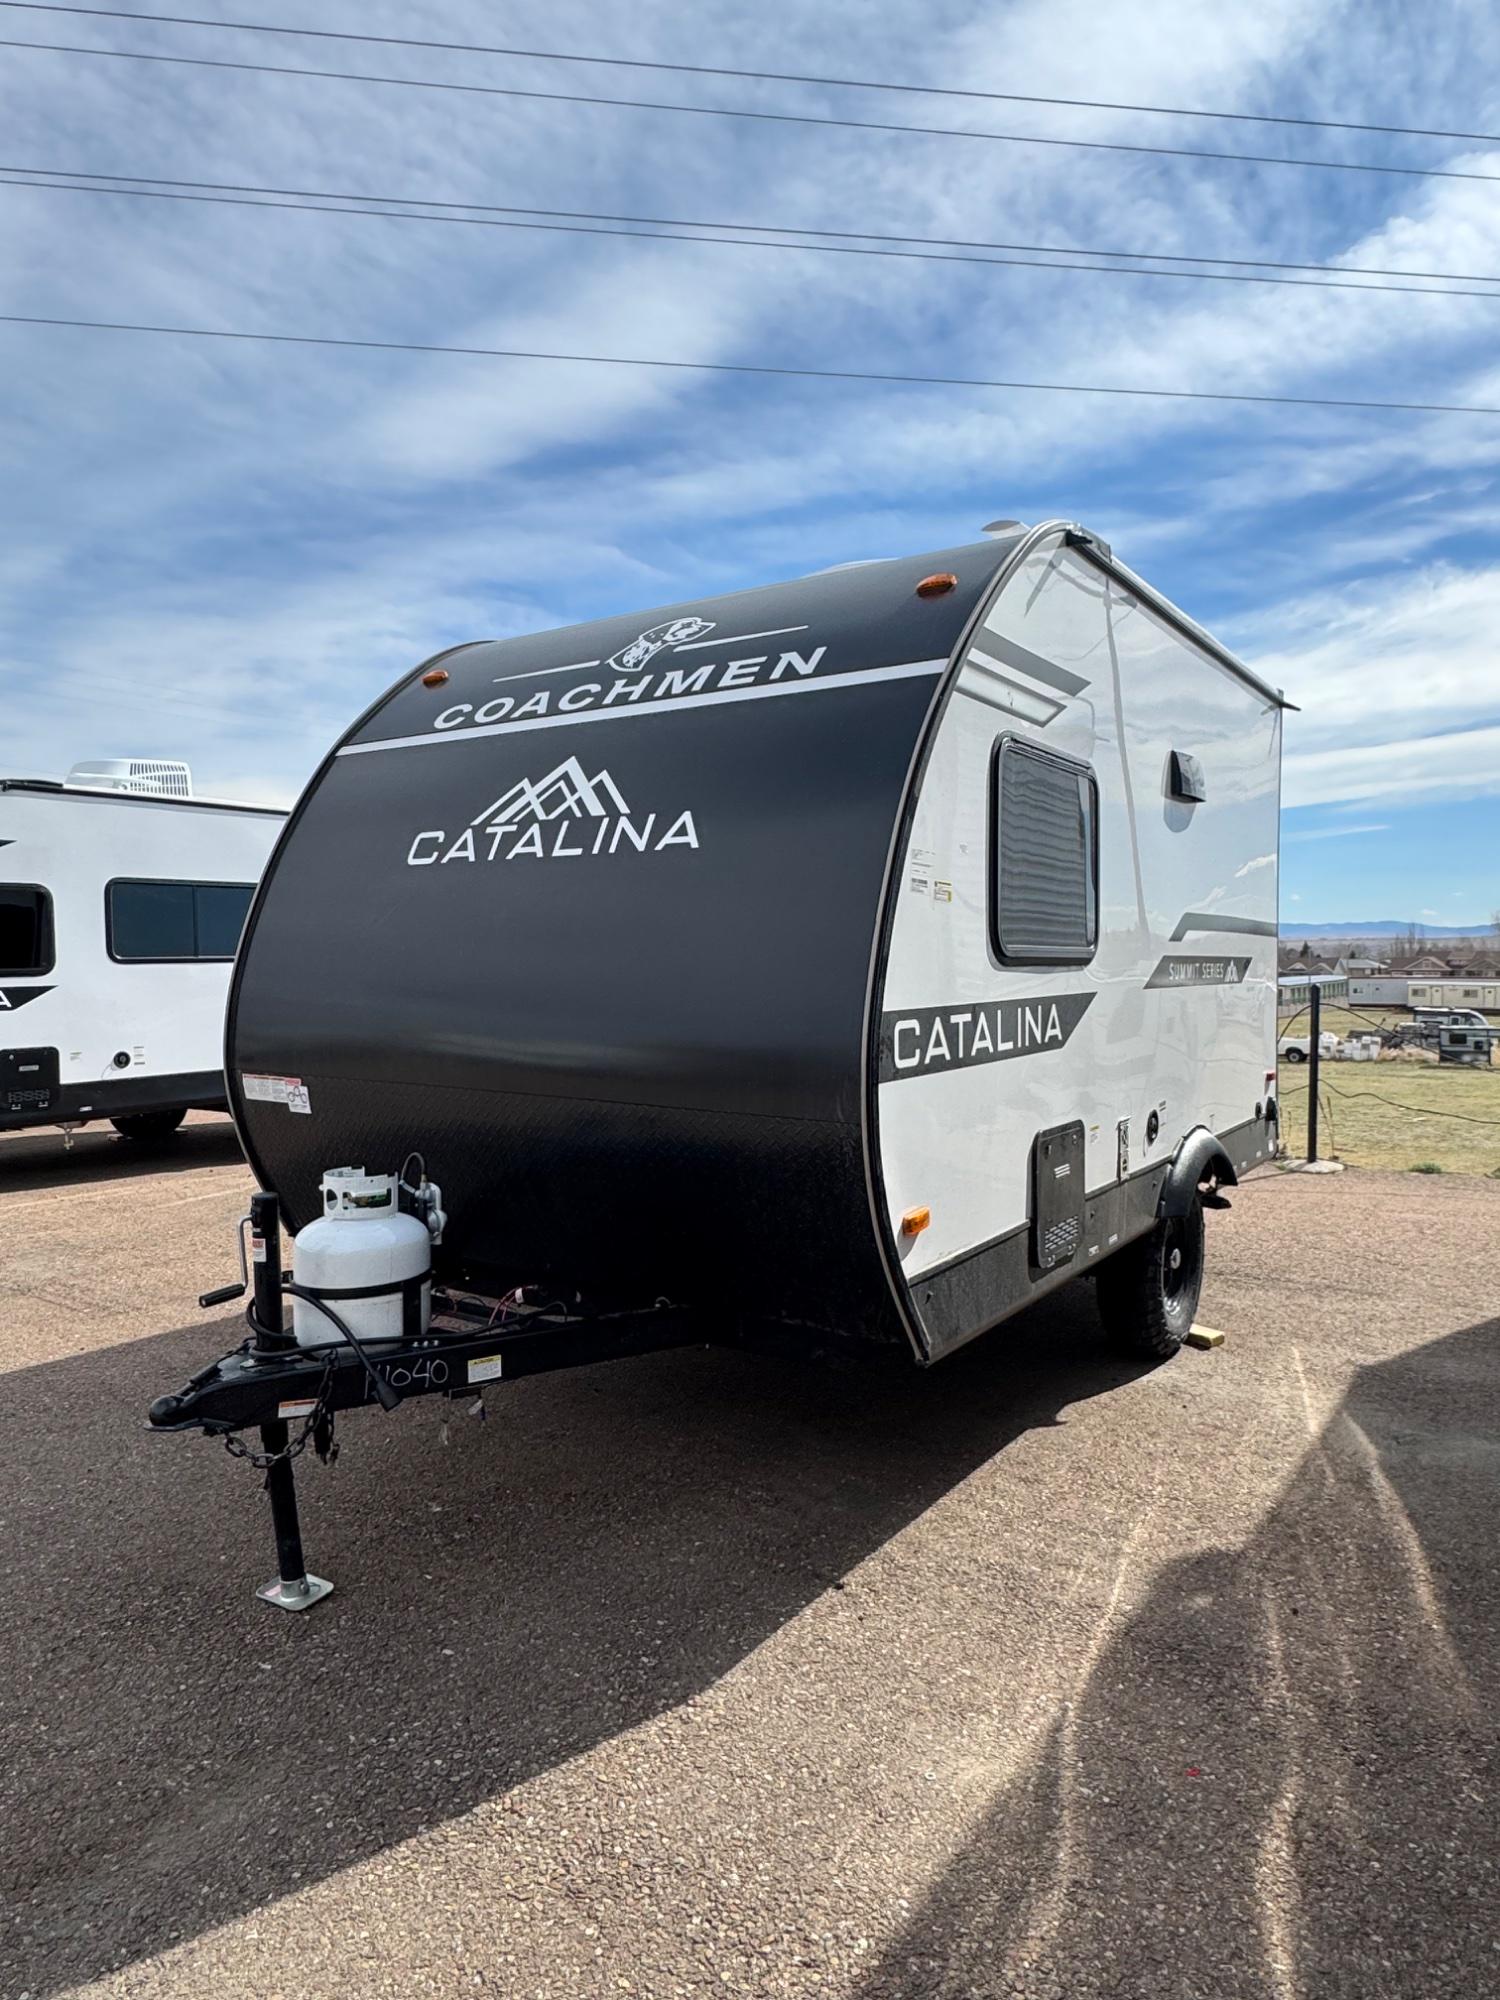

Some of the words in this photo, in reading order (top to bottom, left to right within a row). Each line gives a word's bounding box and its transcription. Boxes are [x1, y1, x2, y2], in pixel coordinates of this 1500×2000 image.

[433, 646, 827, 729] COACHMEN
[407, 810, 700, 865] CATALINA
[1168, 962, 1200, 980] SUMMIT
[1202, 962, 1224, 979] SERIES
[893, 1003, 1063, 1069] CATALINA
